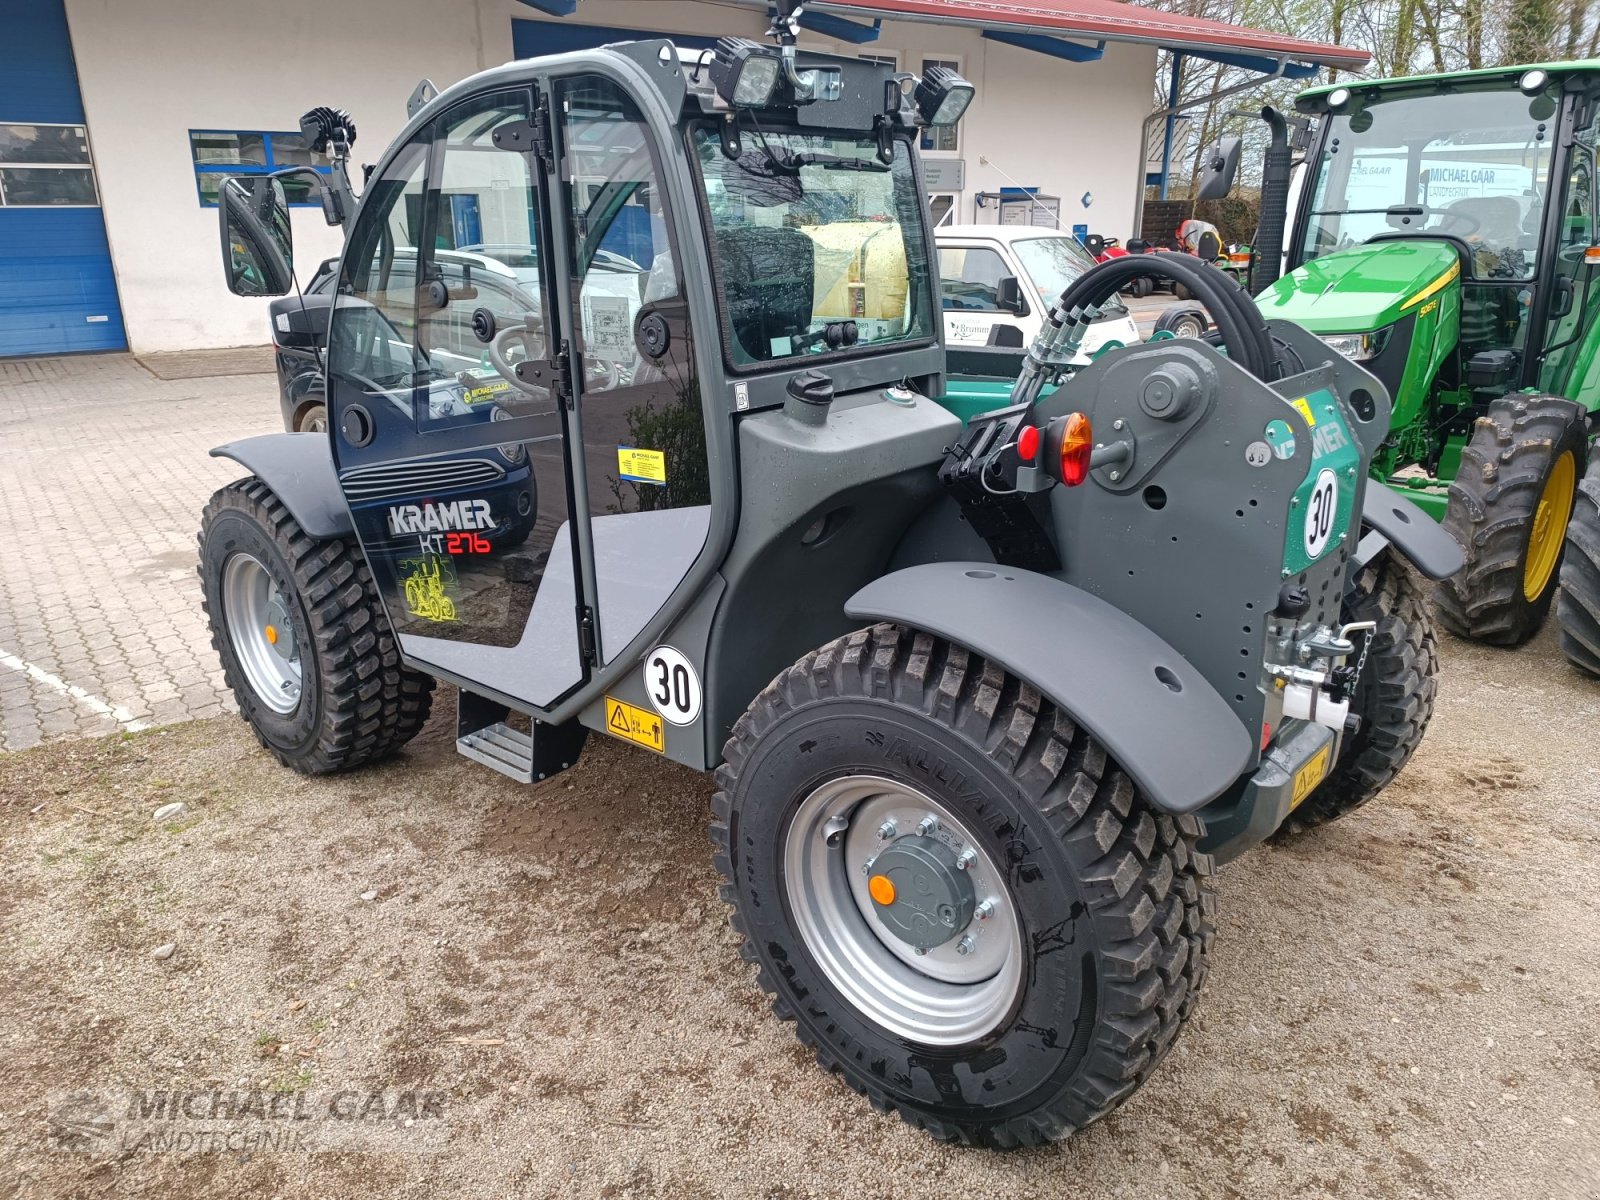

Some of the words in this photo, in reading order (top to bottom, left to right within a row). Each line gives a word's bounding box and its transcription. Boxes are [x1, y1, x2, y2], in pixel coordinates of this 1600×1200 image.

[1430, 168, 1470, 183] MICHAEL
[1471, 170, 1495, 184] GAAR
[389, 499, 497, 534] KRAMER
[1309, 483, 1333, 545] 30
[418, 534, 444, 553] KT
[446, 532, 491, 553] 276
[653, 657, 691, 713] 30
